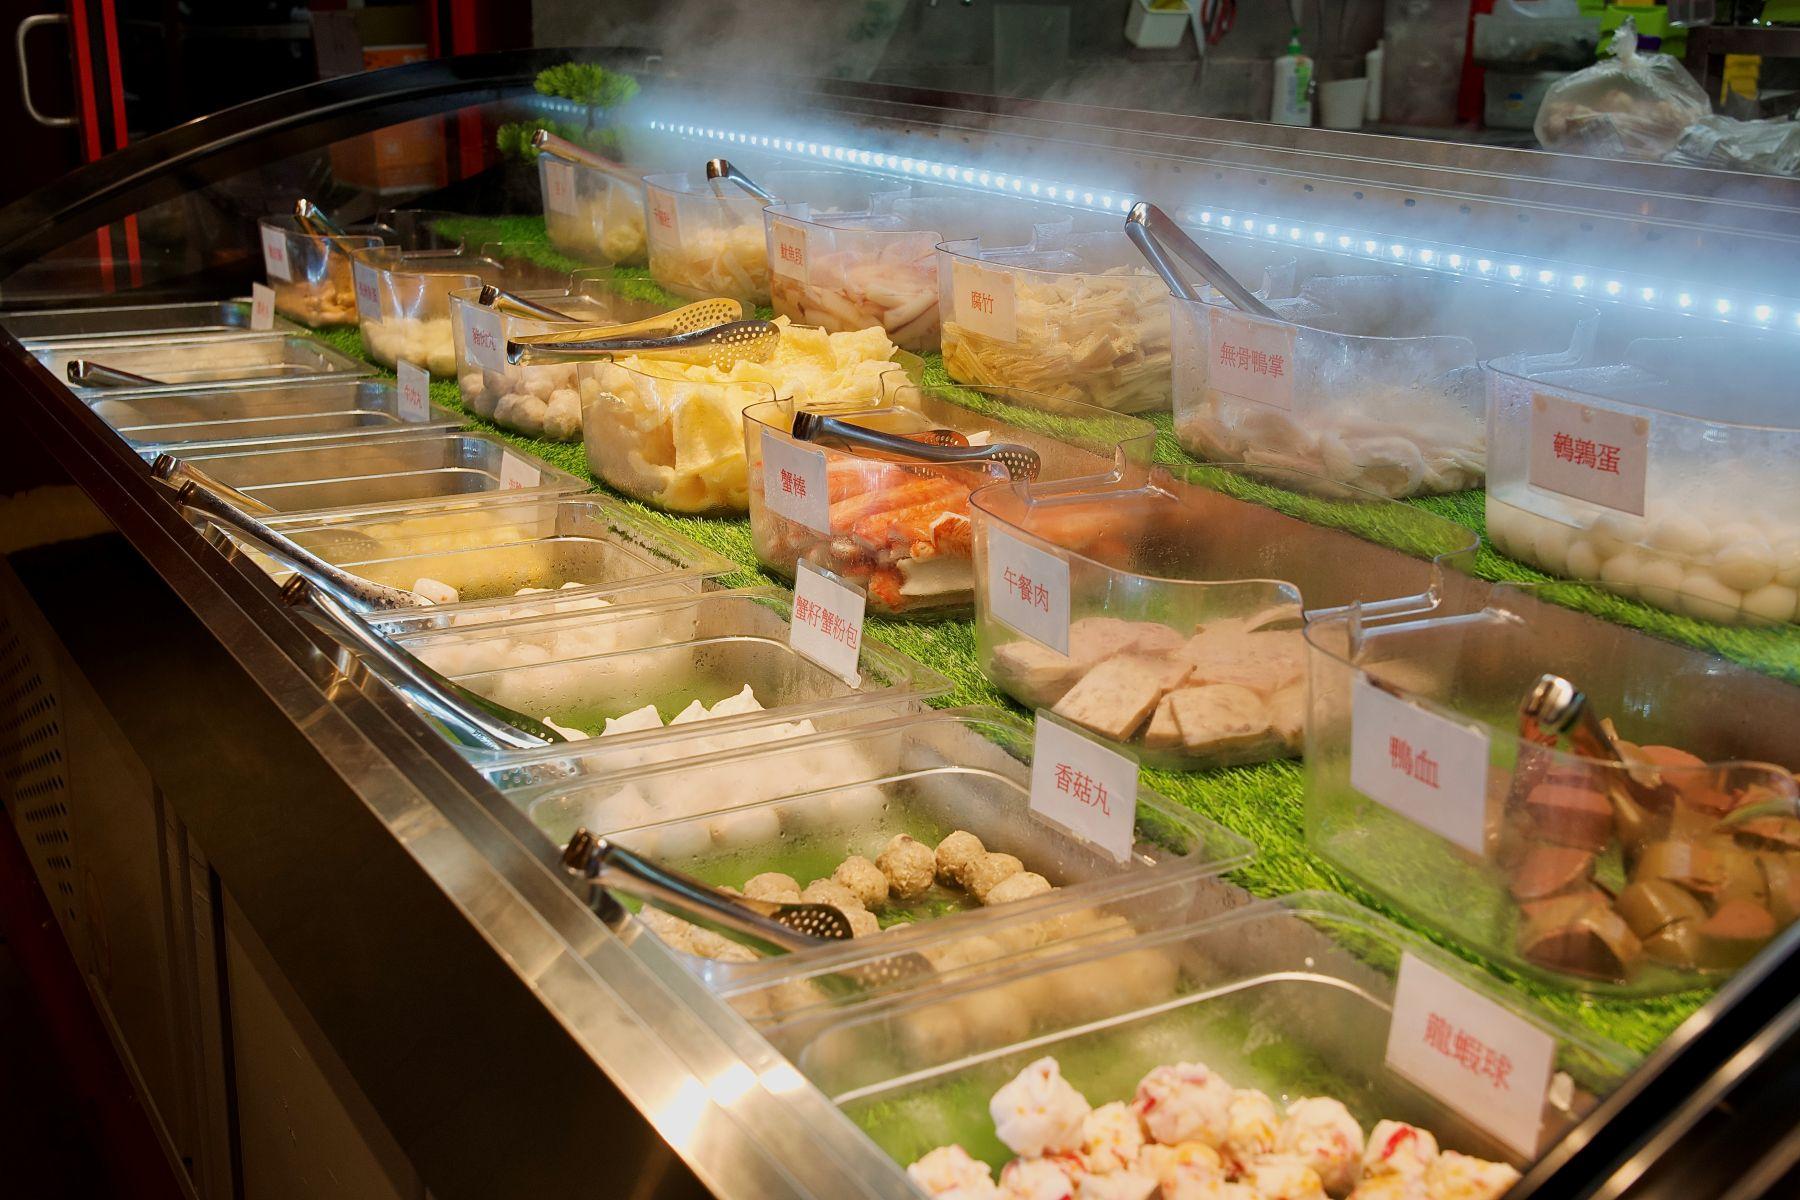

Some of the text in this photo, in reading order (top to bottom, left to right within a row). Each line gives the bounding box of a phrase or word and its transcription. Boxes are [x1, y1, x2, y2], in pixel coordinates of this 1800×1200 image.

[971, 291, 994, 315] 腐竹
[472, 328, 496, 351] 豬肉丸
[1220, 341, 1284, 378] 無骨鴨掌
[1553, 432, 1621, 475] 鵪鶉蛋
[781, 468, 807, 498] 蟹棒
[1003, 566, 1049, 613] 午餐肉
[795, 595, 858, 650] 蟹籽蟹粉包
[1389, 735, 1440, 789] 鴨血
[1054, 762, 1111, 817] 香菇丸
[1424, 1013, 1514, 1090] 龍蝦球
